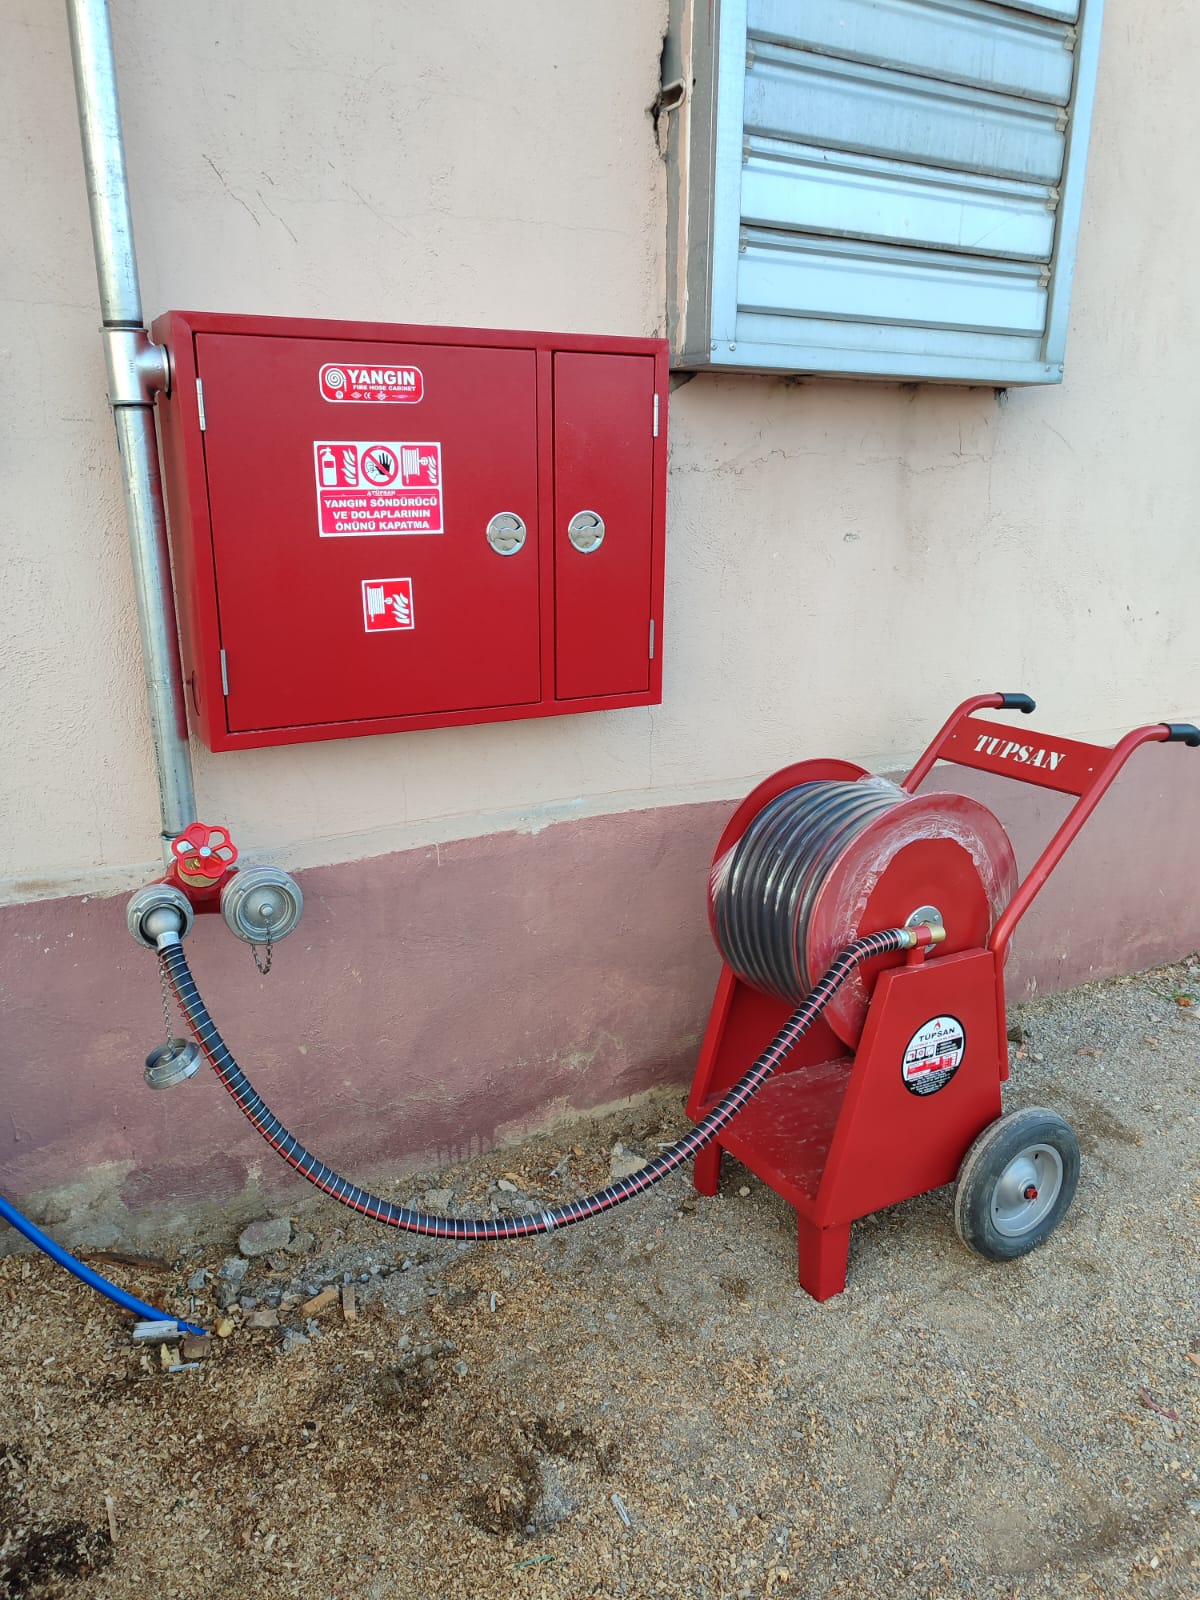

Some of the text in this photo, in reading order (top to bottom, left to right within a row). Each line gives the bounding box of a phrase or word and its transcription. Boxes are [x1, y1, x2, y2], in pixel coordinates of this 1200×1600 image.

[347, 369, 415, 385] YANGIN
[324, 496, 438, 508] YANGIN SÖNDÜRÜCÜ
[332, 509, 431, 520] VE DOLAPLARININ
[335, 520, 430, 531] ÖNÜNÜ KAPATMA
[974, 734, 1066, 771] TUPSAN
